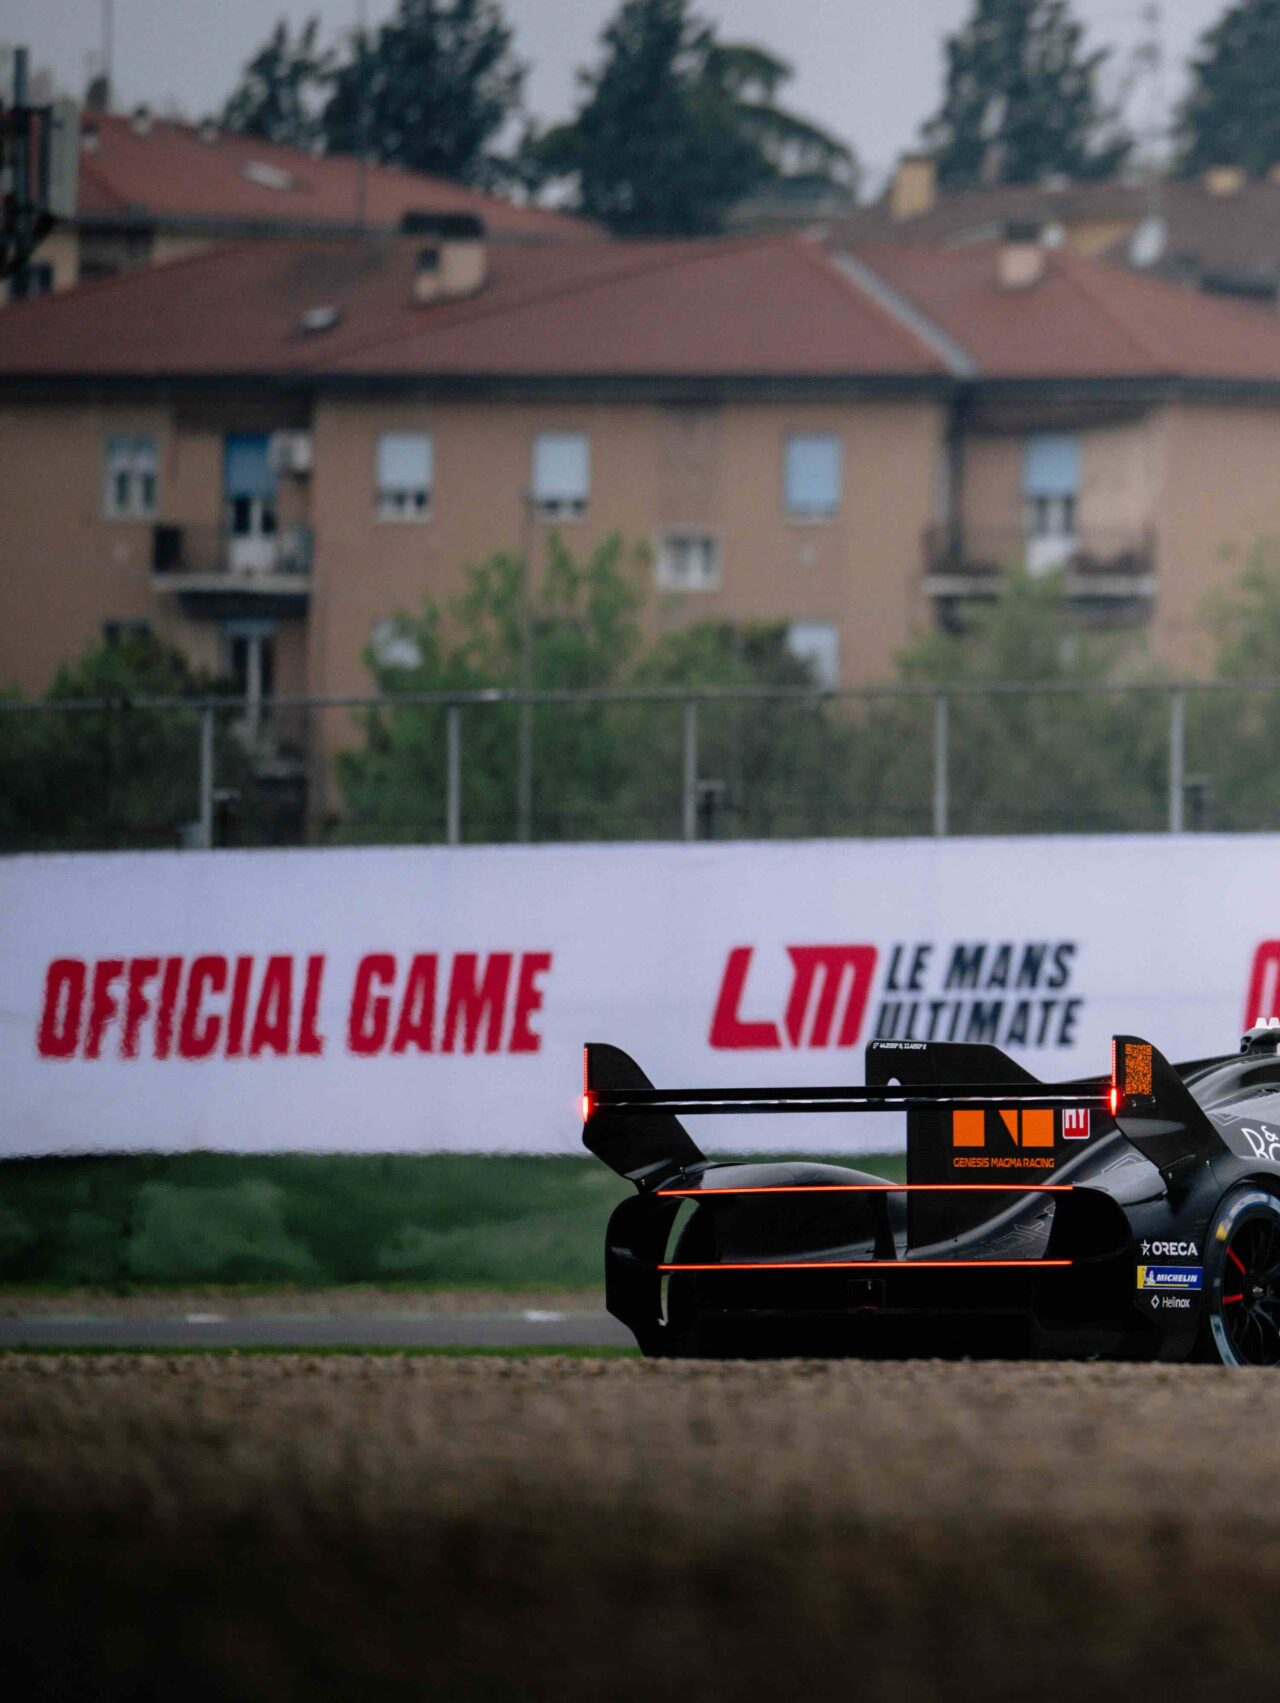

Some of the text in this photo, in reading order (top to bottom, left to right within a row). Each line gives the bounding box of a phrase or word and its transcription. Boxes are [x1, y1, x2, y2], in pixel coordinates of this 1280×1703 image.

[885, 943, 1078, 991] LE MANS
[37, 952, 552, 1060] OFFICIAL GAME
[873, 998, 1084, 1050] ULTIMATE
[953, 1157, 1055, 1168] GENESIS MAGMA RACING
[1152, 1241, 1198, 1256] ORECA
[1156, 1274, 1198, 1283] MICHELIN
[1162, 1296, 1191, 1309] Helinox
